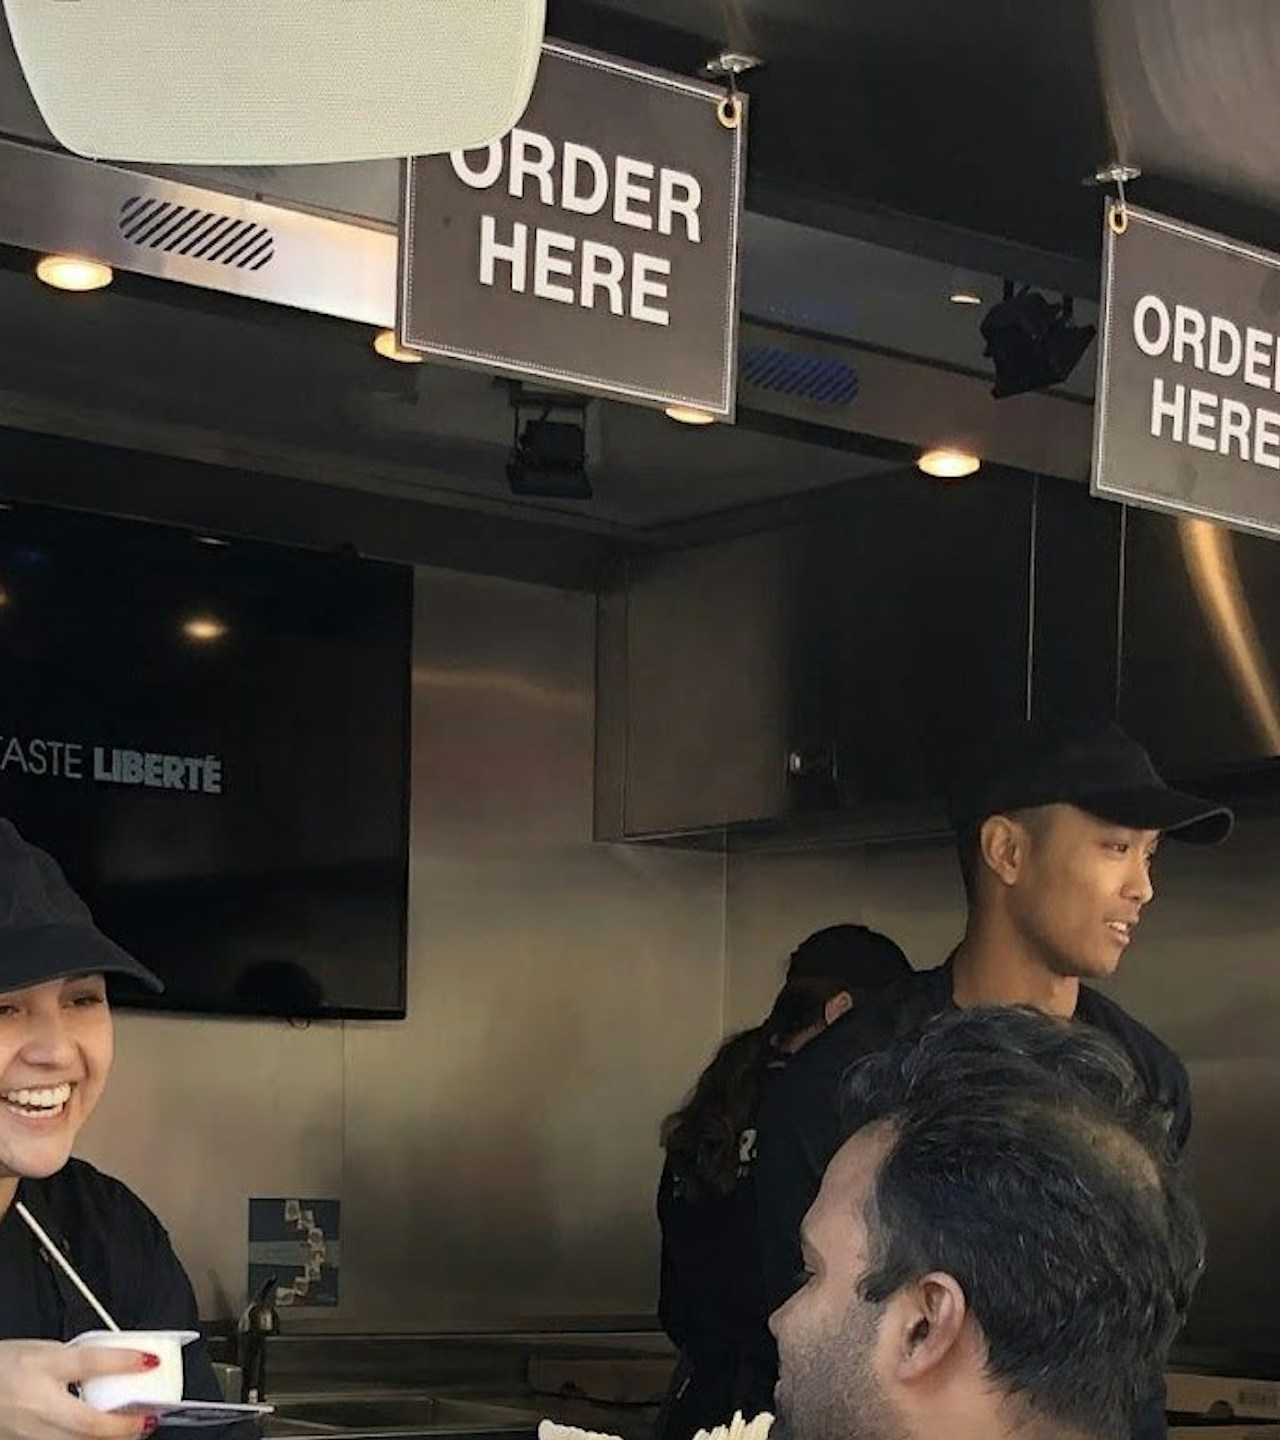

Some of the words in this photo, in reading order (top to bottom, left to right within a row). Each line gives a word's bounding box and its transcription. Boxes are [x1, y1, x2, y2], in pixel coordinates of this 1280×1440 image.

[450, 128, 702, 243] ORDER
[480, 215, 671, 326] HERE
[93, 745, 221, 793] LIBERTÉ
